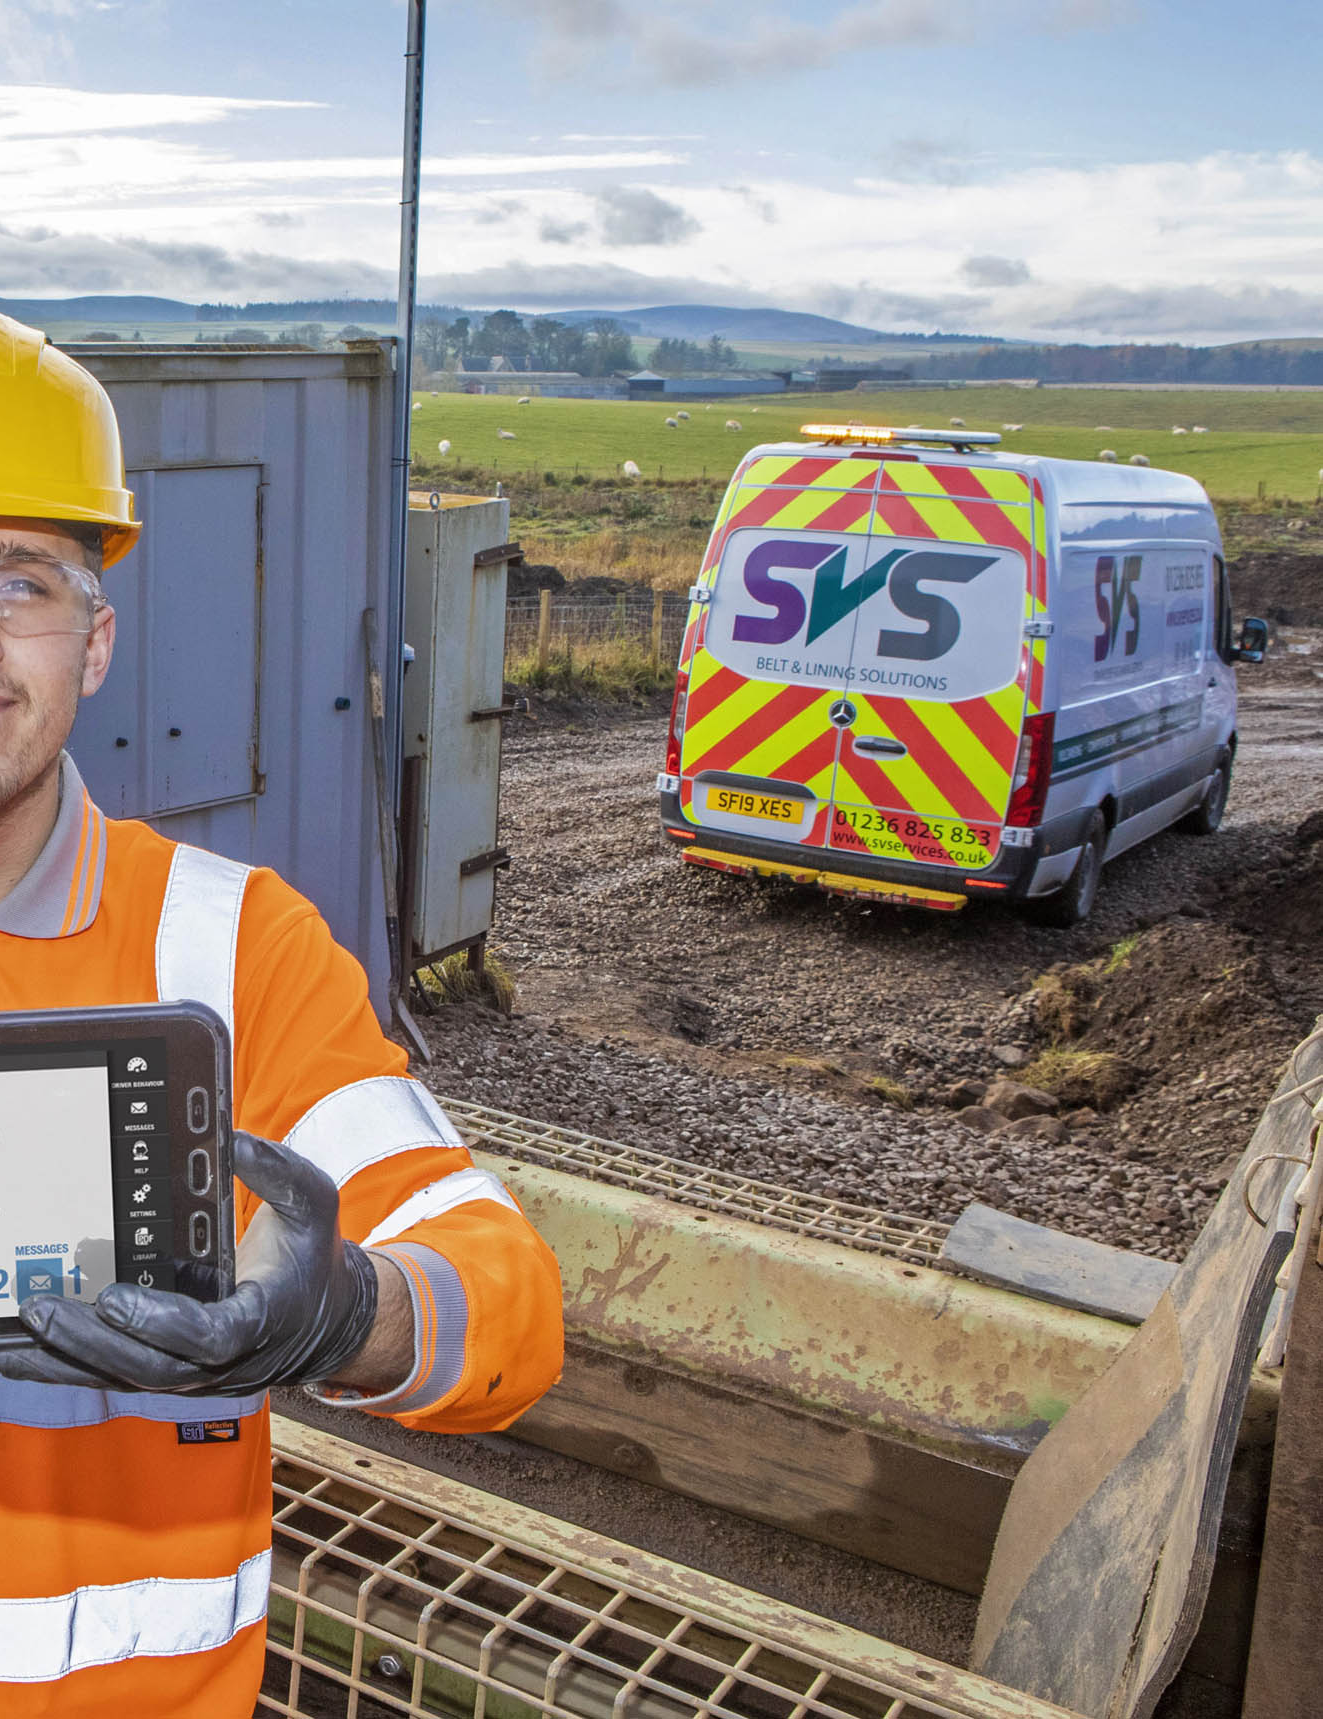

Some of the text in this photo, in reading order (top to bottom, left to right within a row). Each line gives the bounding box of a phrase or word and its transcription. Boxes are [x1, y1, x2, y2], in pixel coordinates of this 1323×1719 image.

[732, 539, 1001, 661] SVS
[1094, 556, 1143, 662] SVS
[756, 656, 948, 691] BELT & LINING SOLUTIONS
[718, 792, 793, 818] SF19 XES
[835, 810, 992, 846] 01236 825 853
[833, 830, 988, 865] www.svservices.co.uk
[124, 1124, 155, 1132] MESSAGES
[129, 1210, 157, 1218] SETTINGS
[15, 1243, 69, 1257] MESSAGES
[132, 1253, 158, 1261] LIBRARY
[67, 1264, 81, 1295] 1
